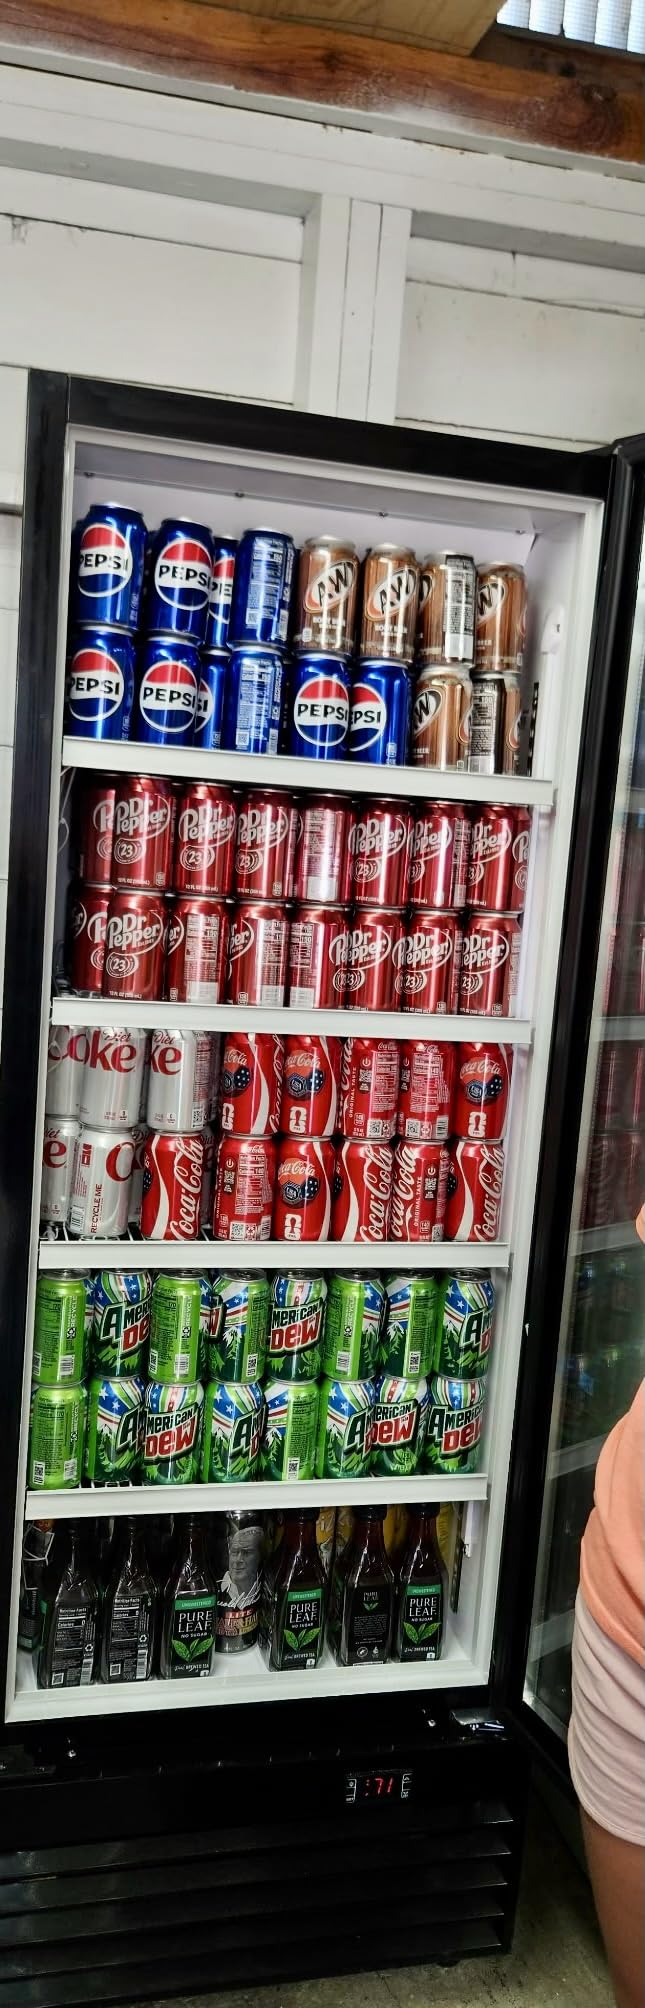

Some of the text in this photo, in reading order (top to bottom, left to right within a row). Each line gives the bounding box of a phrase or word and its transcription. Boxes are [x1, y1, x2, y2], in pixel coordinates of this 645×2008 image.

[71, 677, 120, 696] PEPSI
[143, 686, 195, 708] PEPSI
[297, 703, 348, 721] PEPSI
[129, 797, 153, 816] Dr
[198, 805, 222, 826] Dr
[115, 800, 167, 836] Pepper
[182, 808, 234, 844] Pepper
[120, 844, 133, 857] 23
[122, 913, 147, 931] Dr
[107, 916, 161, 951] Pepper
[352, 930, 372, 948] Dr
[413, 932, 432, 949] Dr
[470, 934, 491, 950] Dr
[112, 958, 126, 971] 23
[90, 1184, 103, 1234] RECYCLE ME
[289, 1601, 318, 1614] PURE
[409, 1597, 438, 1608] PURE
[179, 1610, 213, 1622] PURE
[289, 1611, 317, 1624] LEAF
[409, 1607, 437, 1617] LEAF
[178, 1621, 212, 1633] LEAF
